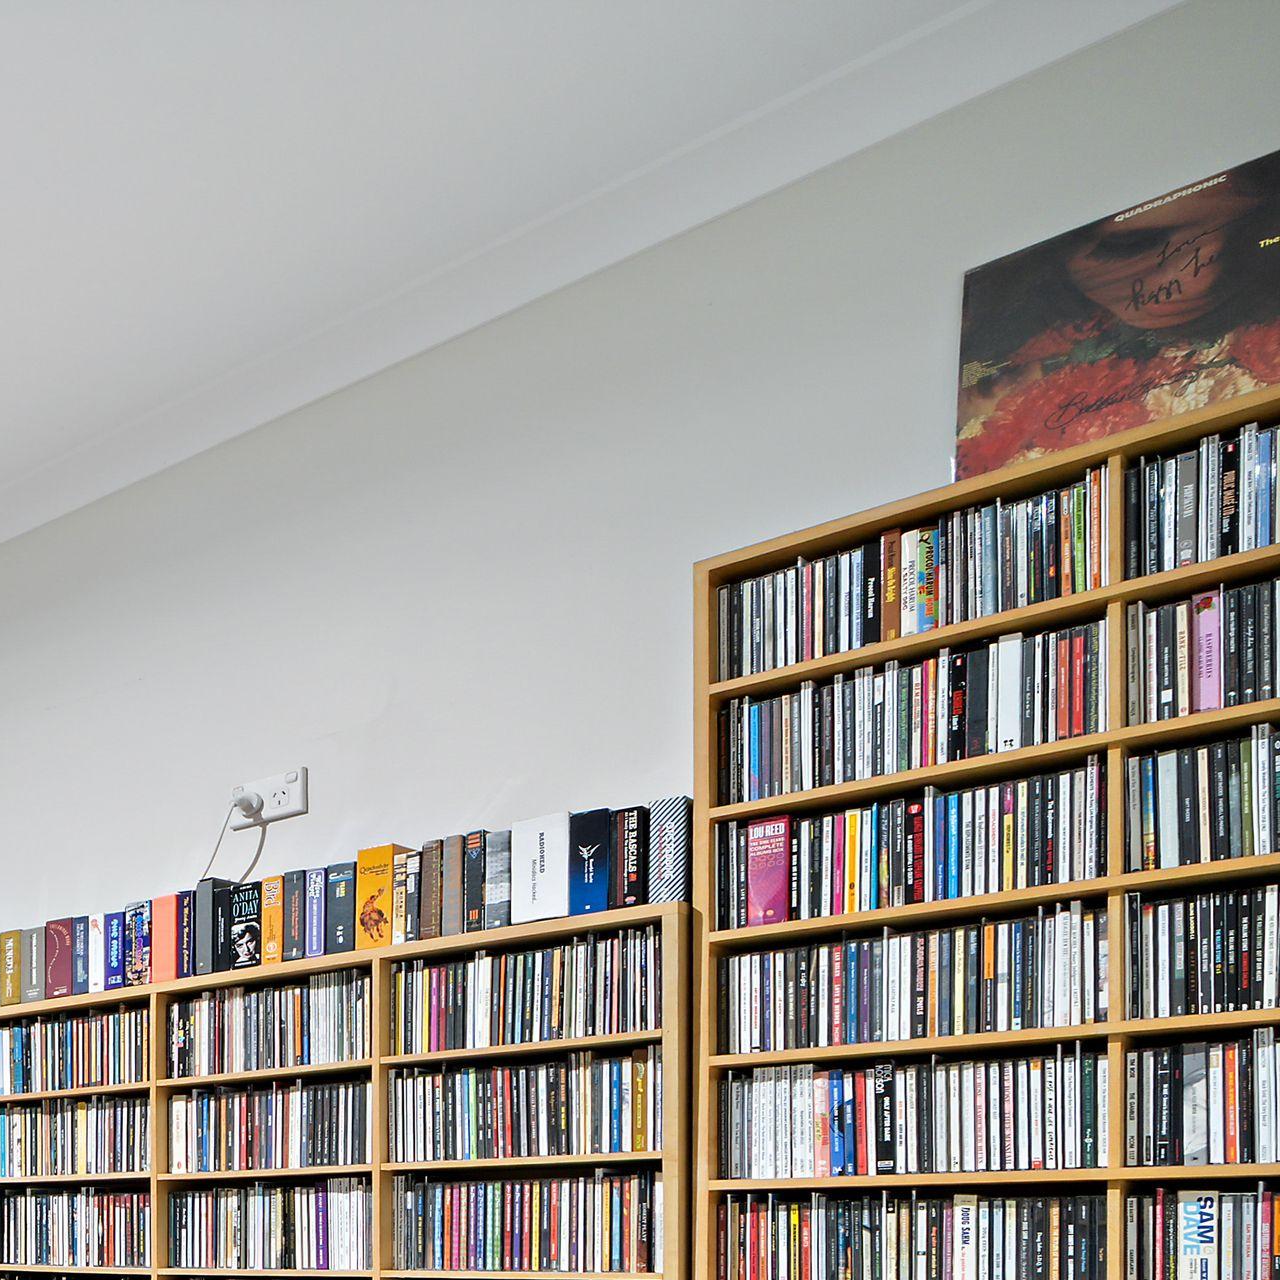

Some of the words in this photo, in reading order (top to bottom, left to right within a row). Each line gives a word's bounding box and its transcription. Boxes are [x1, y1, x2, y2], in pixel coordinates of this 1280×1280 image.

[1114, 174, 1228, 222] QUADRAPHONIC
[1205, 633, 1213, 679] RASPBERRIES
[629, 810, 638, 831] THE
[750, 825, 764, 840] LOU
[766, 823, 785, 836] REED
[628, 832, 637, 872] RASCALS
[232, 890, 258, 903] ANITA
[233, 900, 259, 916] O'DAY
[264, 880, 281, 908] Bird
[1182, 1201, 1201, 1256] DAVE
[1196, 1196, 1214, 1244] SAM
